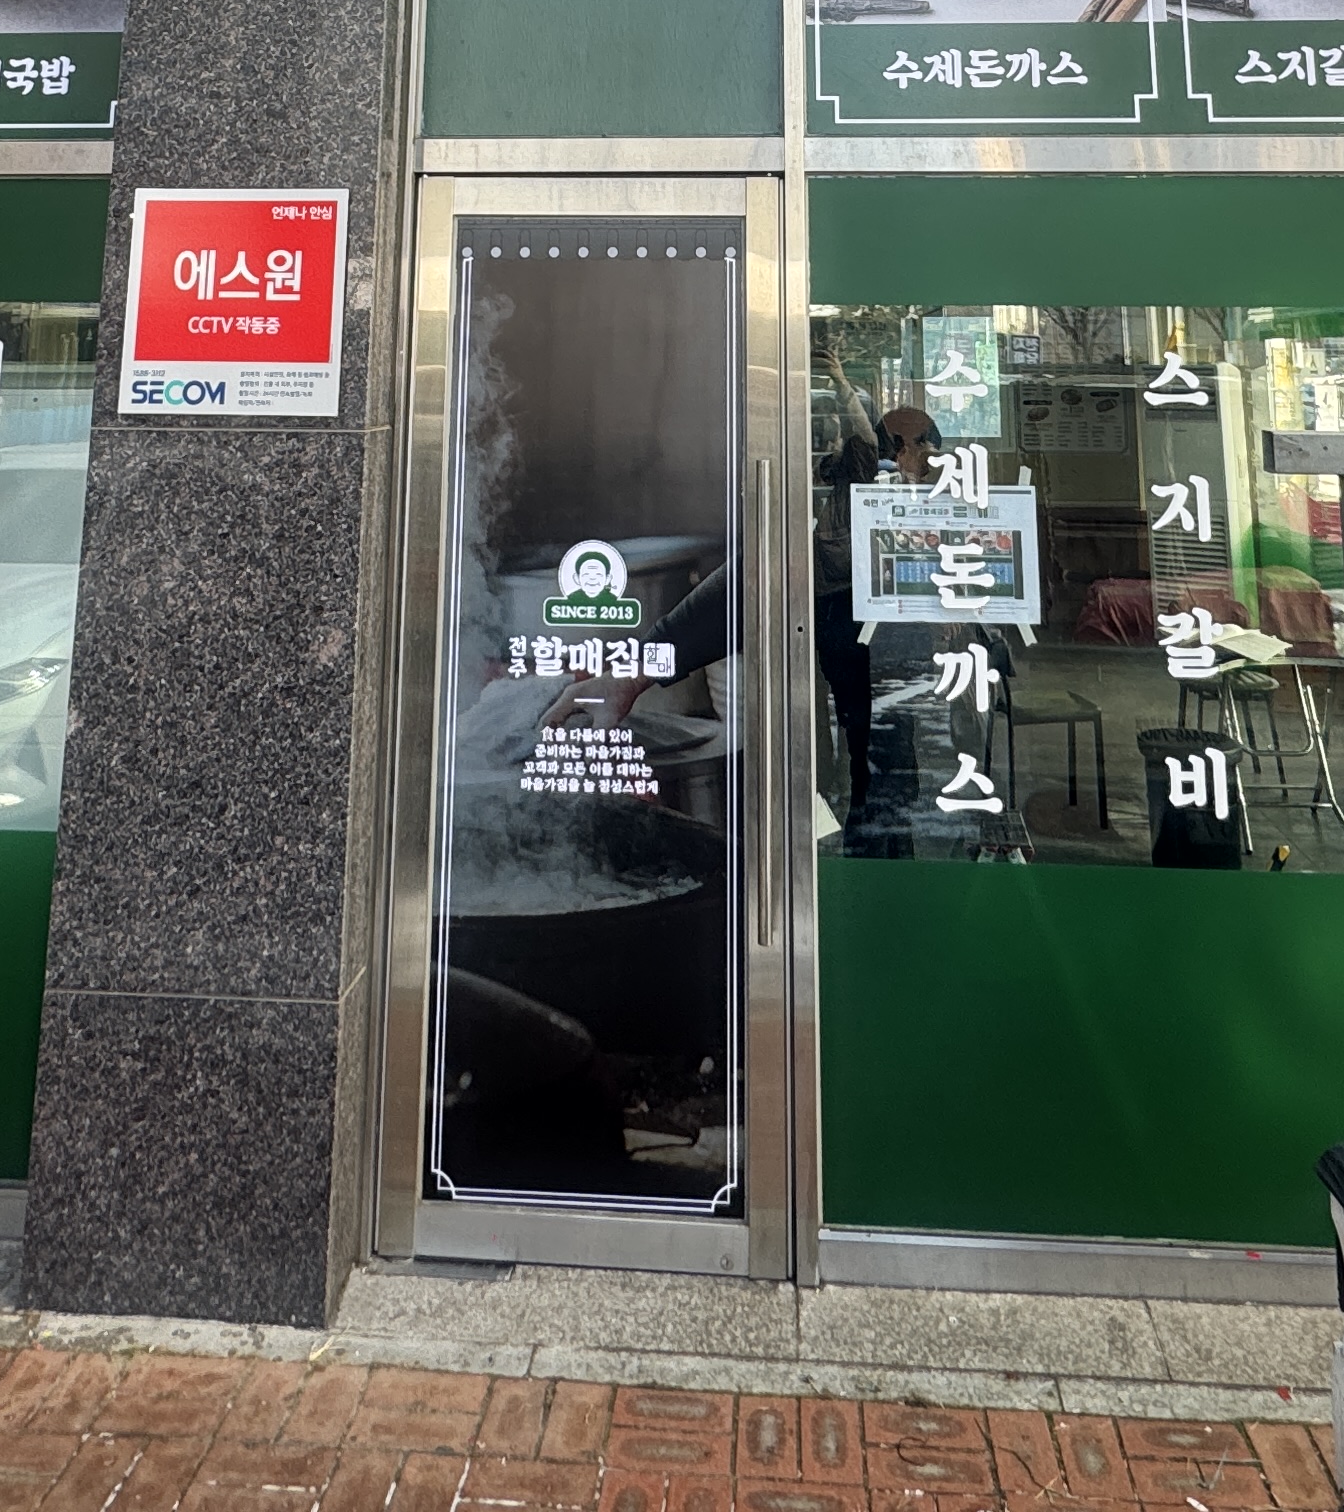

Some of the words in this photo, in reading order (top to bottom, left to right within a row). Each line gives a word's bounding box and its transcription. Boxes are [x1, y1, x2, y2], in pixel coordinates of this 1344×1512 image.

[881, 47, 1089, 90] 수제돈까스
[271, 206, 307, 220] 언제나
[309, 206, 333, 220] 안심
[173, 249, 303, 301] 에스원
[188, 316, 233, 333] CCTV
[235, 316, 281, 334] 작동중
[131, 380, 226, 405] SECOM
[924, 350, 1003, 814] 수제돈까스
[1143, 351, 1229, 819] 스지갈비
[551, 605, 597, 619] SINCE
[600, 605, 634, 620] 2013
[508, 636, 527, 678] 전주
[531, 636, 640, 678] 할매집
[561, 761, 586, 776] 모든
